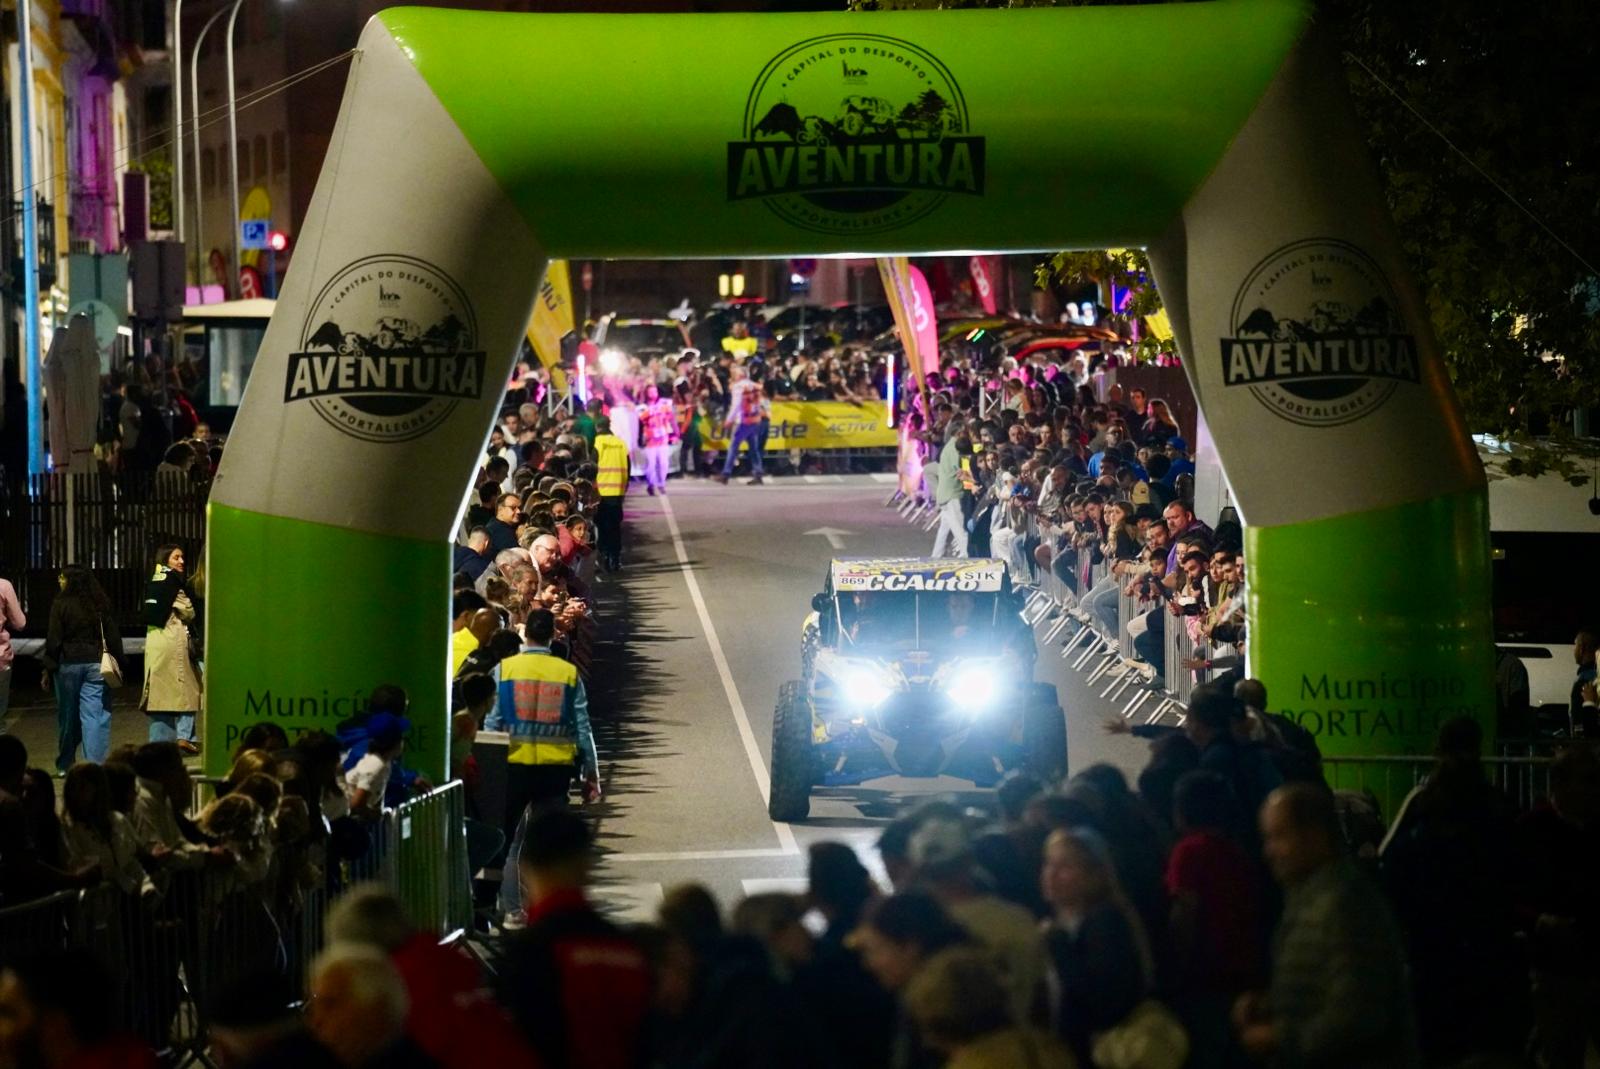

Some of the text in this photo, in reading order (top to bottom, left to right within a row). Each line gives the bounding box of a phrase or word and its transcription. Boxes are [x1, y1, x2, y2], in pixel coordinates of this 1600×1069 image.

[787, 47, 926, 81] CAPITAL DO DESPORTO
[736, 142, 977, 196] AVENTURA
[334, 274, 373, 303] CAPITAL
[378, 271, 393, 279] DO
[1229, 338, 1416, 383] AVENTURA
[290, 356, 477, 398] AVENTURA
[339, 410, 426, 433] PORTALEGRE
[1279, 396, 1365, 417] PORTALEGRE
[868, 573, 978, 592] CCAuto
[244, 688, 370, 717] Municí
